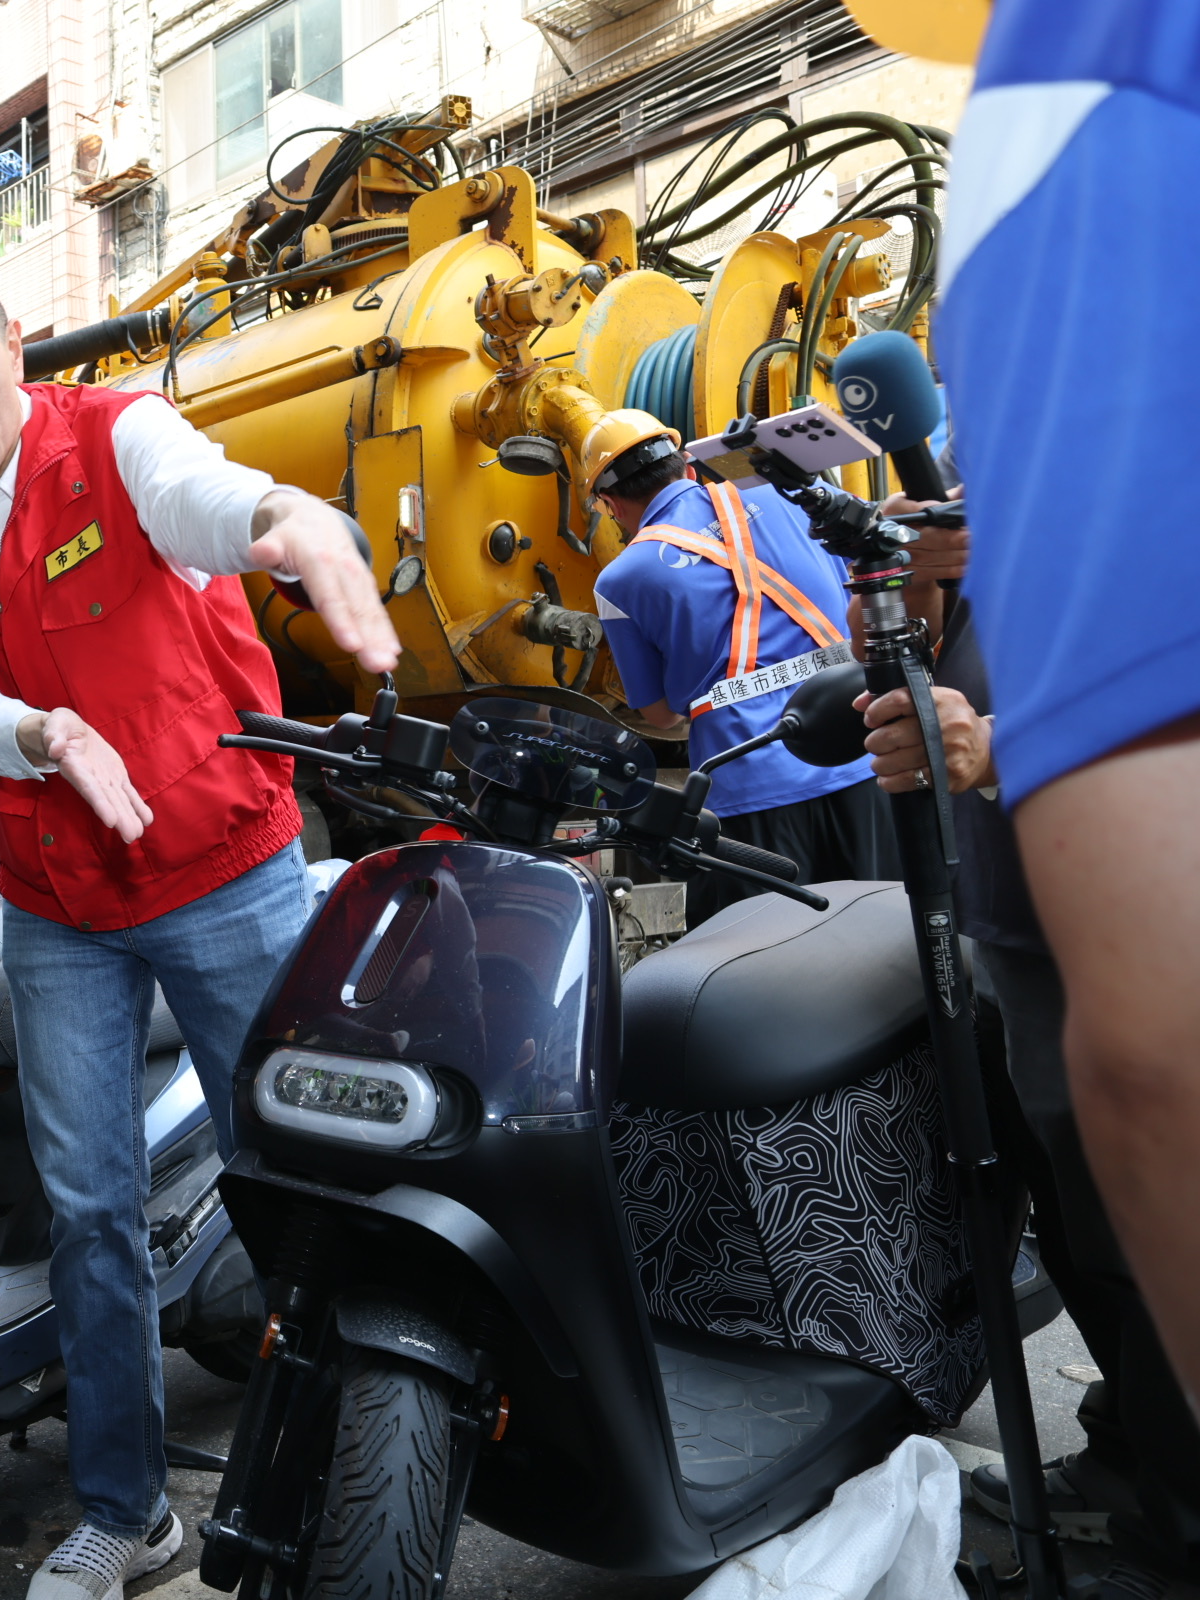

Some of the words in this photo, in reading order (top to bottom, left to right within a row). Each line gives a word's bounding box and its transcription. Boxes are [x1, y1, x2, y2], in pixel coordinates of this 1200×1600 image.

[843, 413, 895, 435] TV
[55, 535, 90, 569] 市長
[710, 645, 854, 706] 基隆市環境保護
[398, 1335, 436, 1352] gogoro
